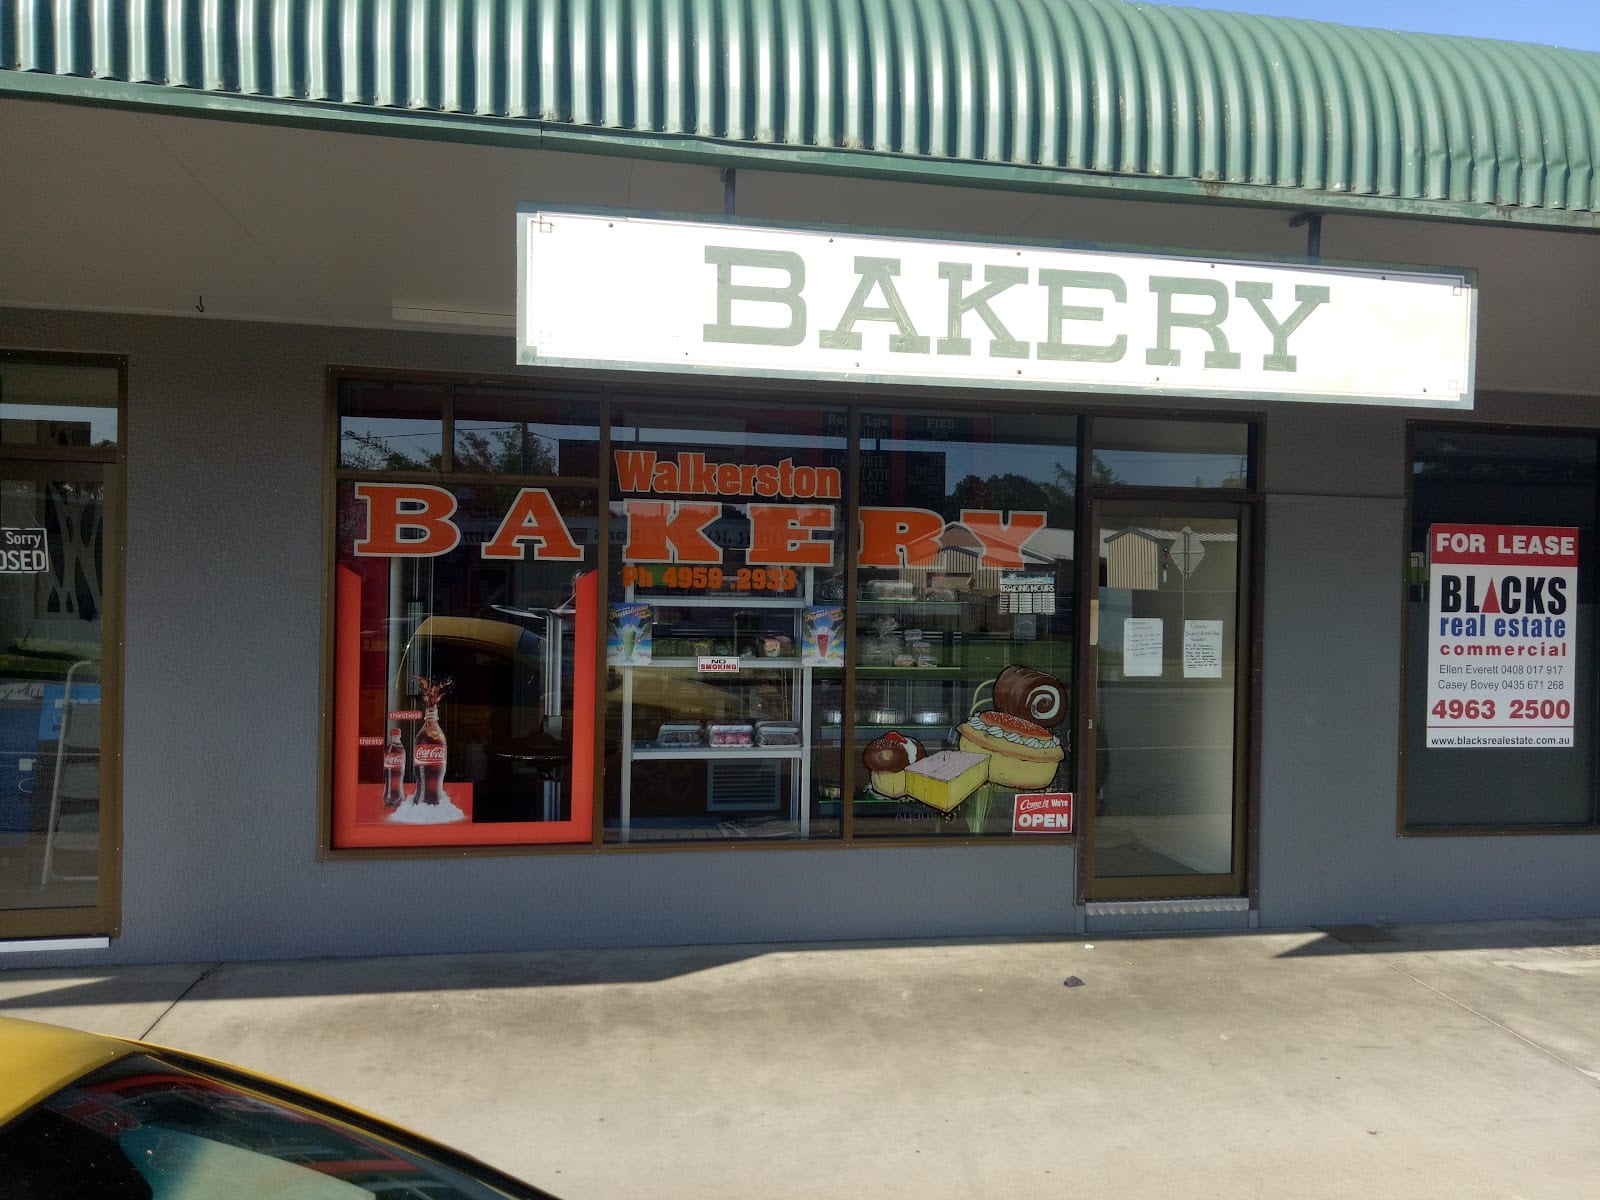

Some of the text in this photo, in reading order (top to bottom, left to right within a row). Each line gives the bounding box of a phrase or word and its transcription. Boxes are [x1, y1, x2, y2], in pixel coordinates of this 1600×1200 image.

[703, 245, 1331, 373] BAKERY
[614, 450, 842, 499] Walkerston
[354, 482, 1048, 571] BAKERY
[6, 531, 42, 549] Sorry
[1436, 533, 1575, 556] FOR LEASE
[622, 566, 654, 588] Ph
[1031, 584, 1056, 593] HOURS
[1440, 613, 1566, 638] real estate
[1440, 642, 1567, 657] commercial
[1439, 664, 1563, 675] Ellen Everett 0408 017 917
[1438, 680, 1564, 692] Casey Bovey 0435 671 268
[1431, 699, 1571, 720] 4963 2500
[359, 738, 383, 746] thirsty
[1431, 735, 1571, 745] www.blacksrealestate.com.au
[1018, 814, 1069, 828] OPEN
